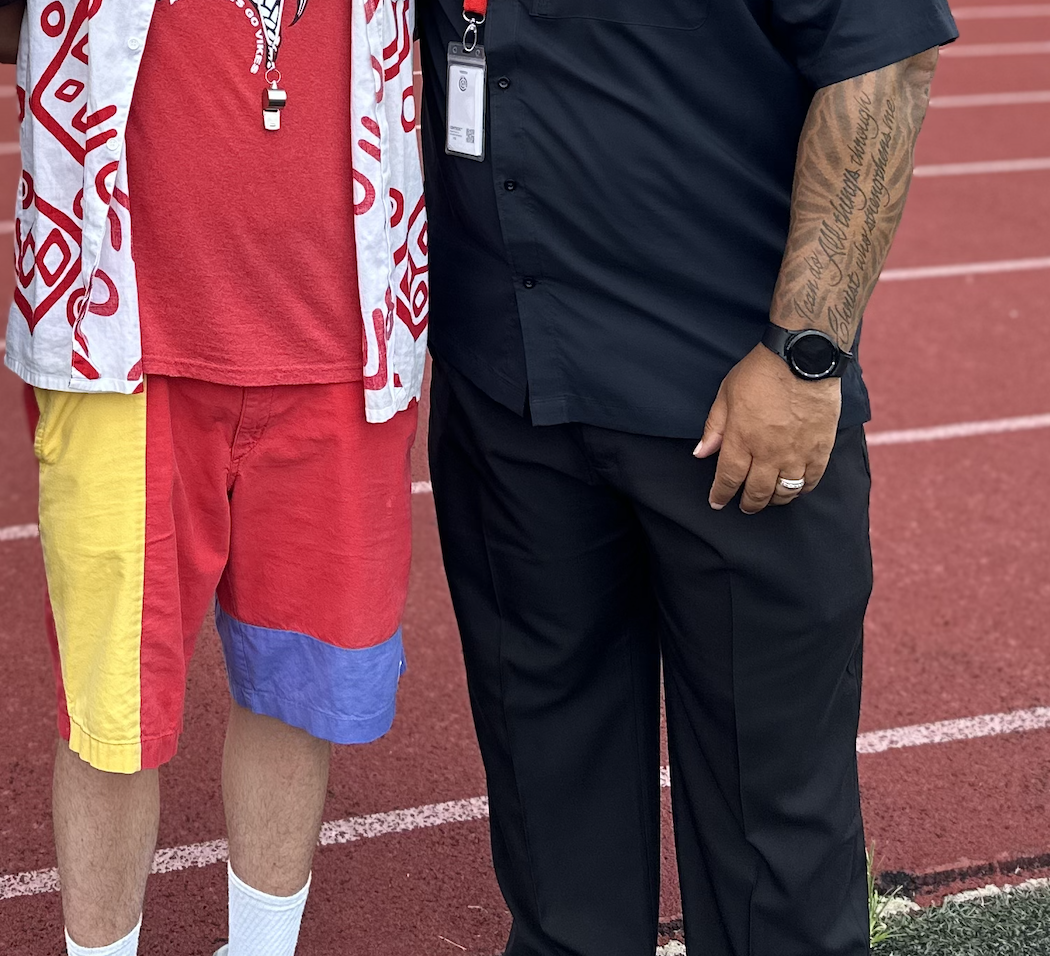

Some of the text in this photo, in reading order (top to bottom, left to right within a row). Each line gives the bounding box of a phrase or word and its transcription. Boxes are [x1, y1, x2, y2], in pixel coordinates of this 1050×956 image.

[244, 8, 260, 27] GO
[250, 29, 265, 75] VIKES
[847, 90, 880, 167] through
[828, 270, 861, 346] Christ
[854, 225, 872, 272] who
[882, 98, 896, 131] me
[830, 167, 868, 229] things
